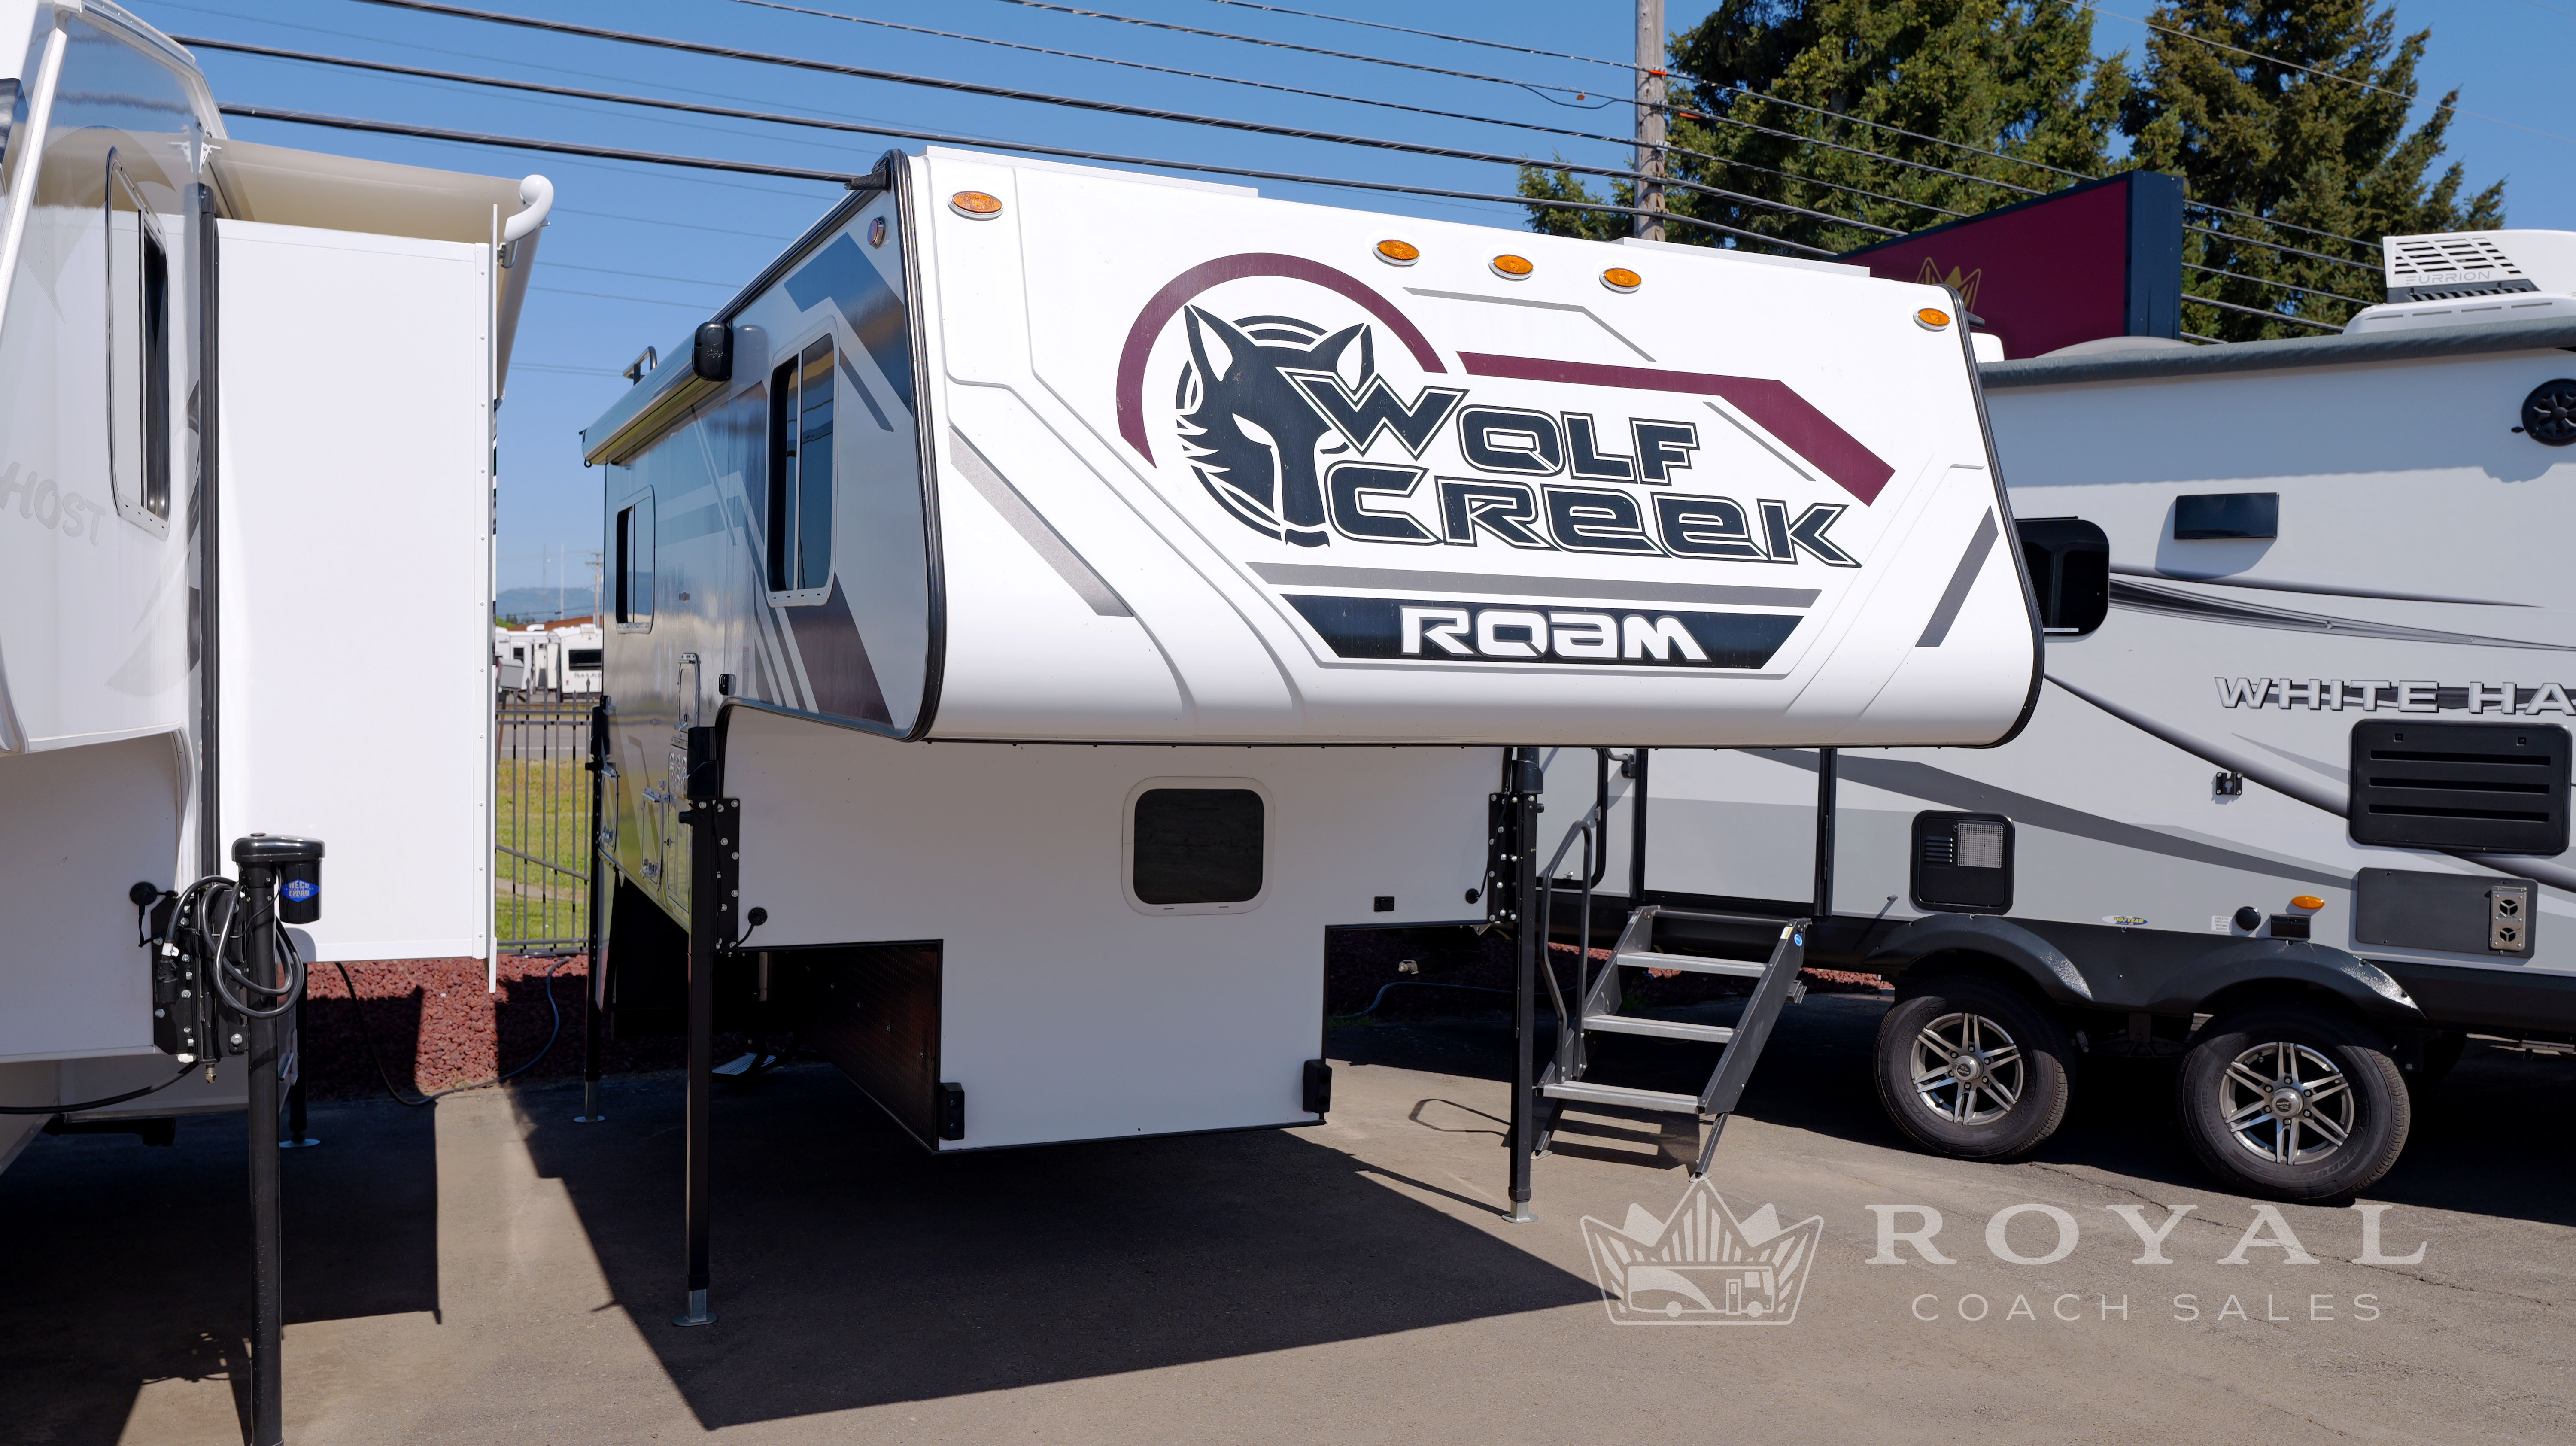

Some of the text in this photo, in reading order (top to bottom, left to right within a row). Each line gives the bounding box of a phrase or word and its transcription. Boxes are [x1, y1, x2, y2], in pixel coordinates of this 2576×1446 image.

[2406, 271, 2490, 285] FURRION
[1282, 368, 1701, 486] WOLF
[0, 461, 107, 546] HOST
[2214, 676, 2576, 716] WHITE HA
[288, 880, 310, 889] RIECO
